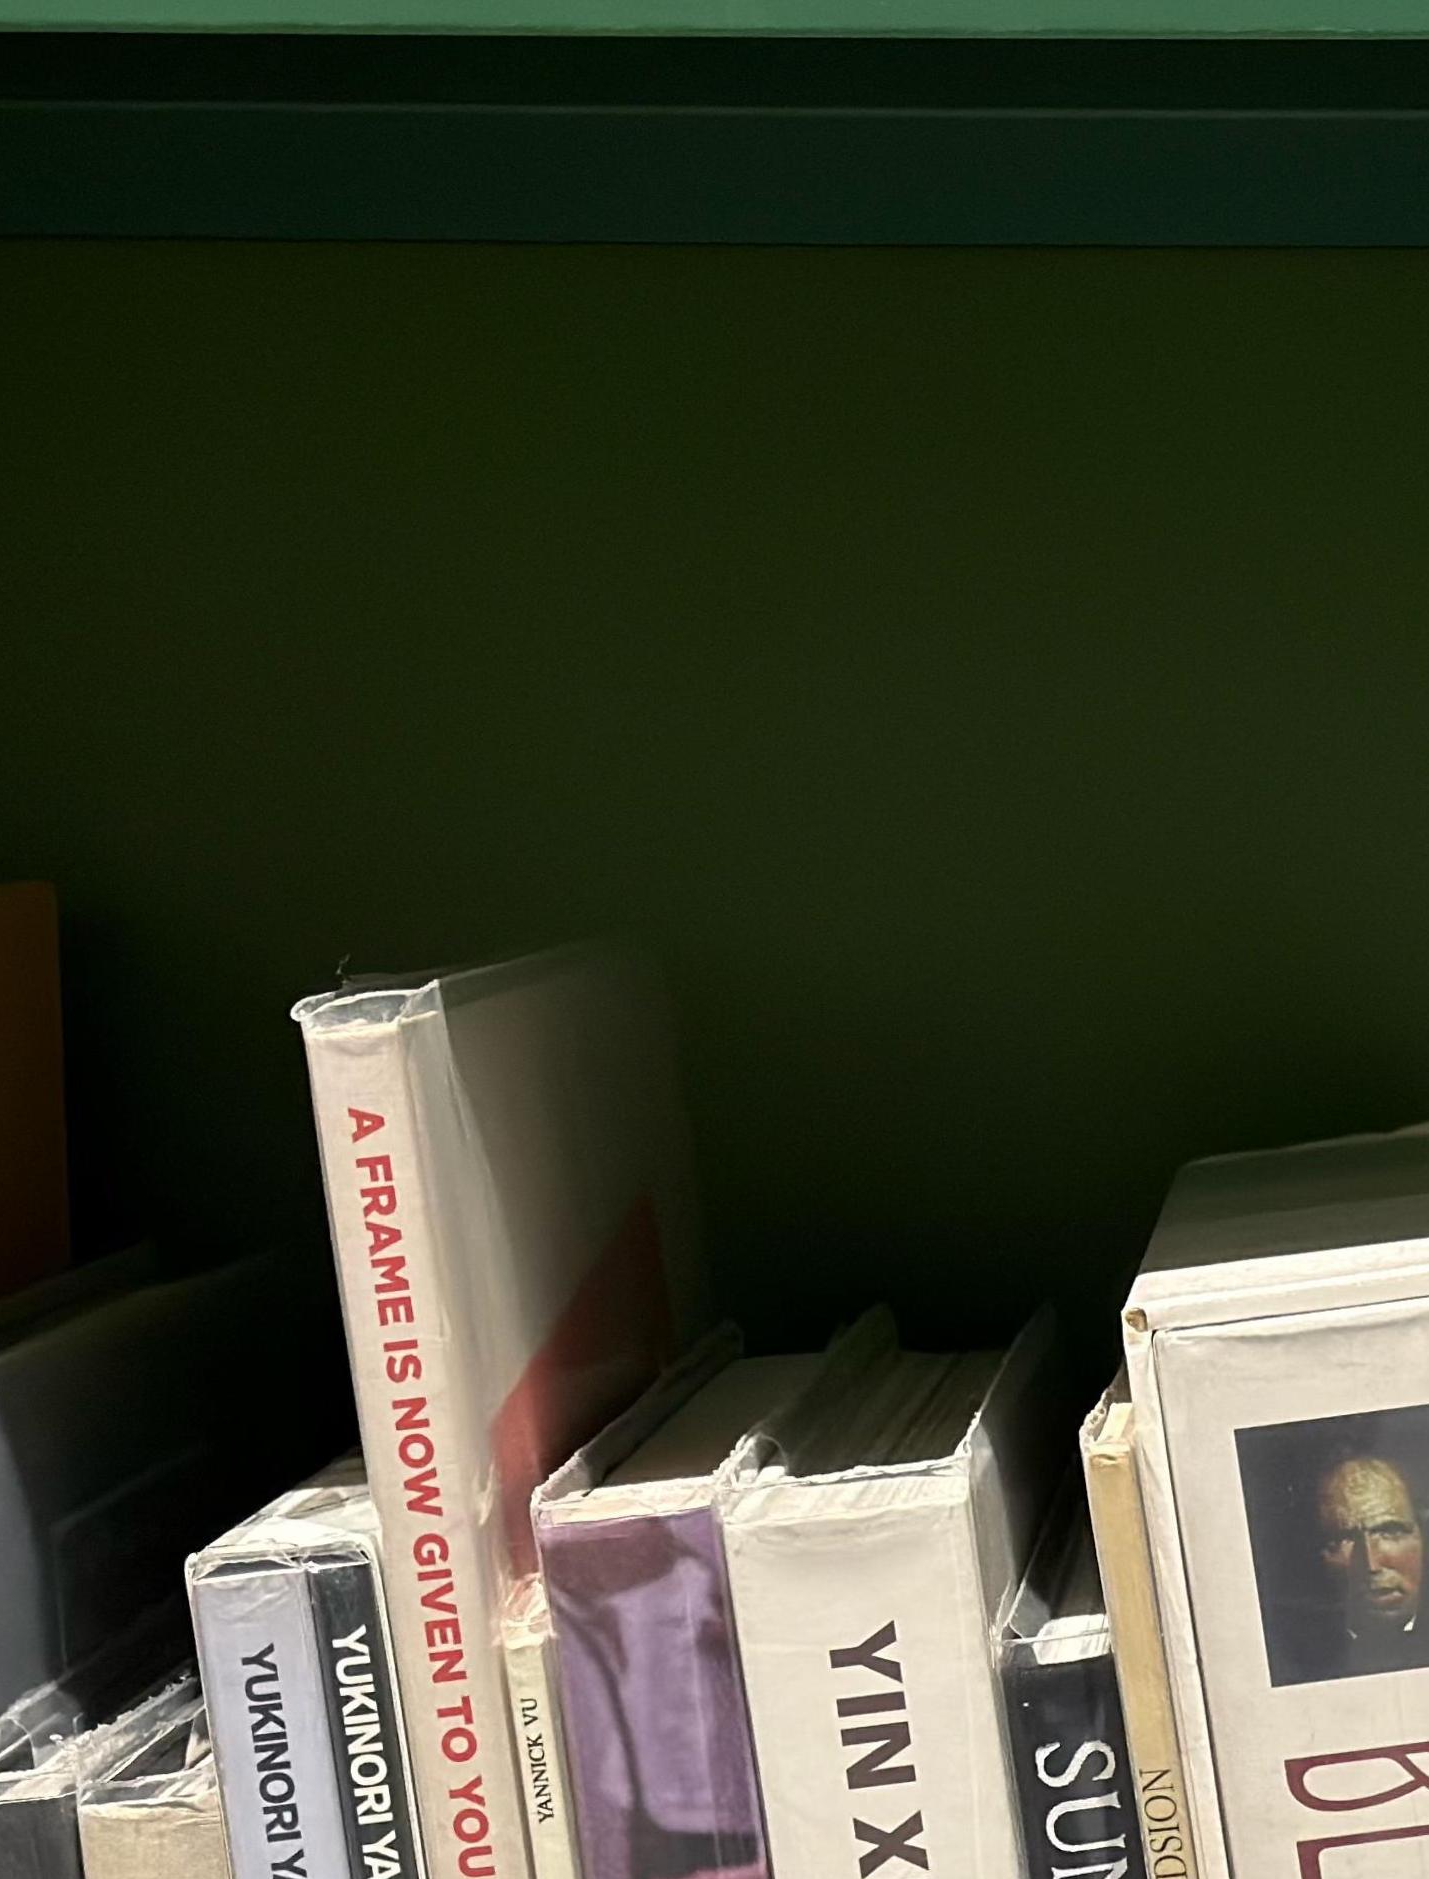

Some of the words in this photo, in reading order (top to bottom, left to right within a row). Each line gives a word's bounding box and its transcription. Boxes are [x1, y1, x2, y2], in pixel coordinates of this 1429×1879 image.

[347, 1106, 386, 1145] A
[354, 1153, 416, 1328] FRAME
[382, 1338, 423, 1385] IS
[390, 1395, 445, 1518] NOW
[411, 1531, 469, 1685] GIVEN
[240, 1642, 303, 1844] YUKINORI
[330, 1624, 394, 1826] YUKINORI
[435, 1694, 479, 1764] TO
[519, 1697, 540, 1728] VU
[829, 1620, 917, 1790] YIN
[447, 1774, 497, 1879] YOU
[525, 1732, 556, 1825] YANNICK
